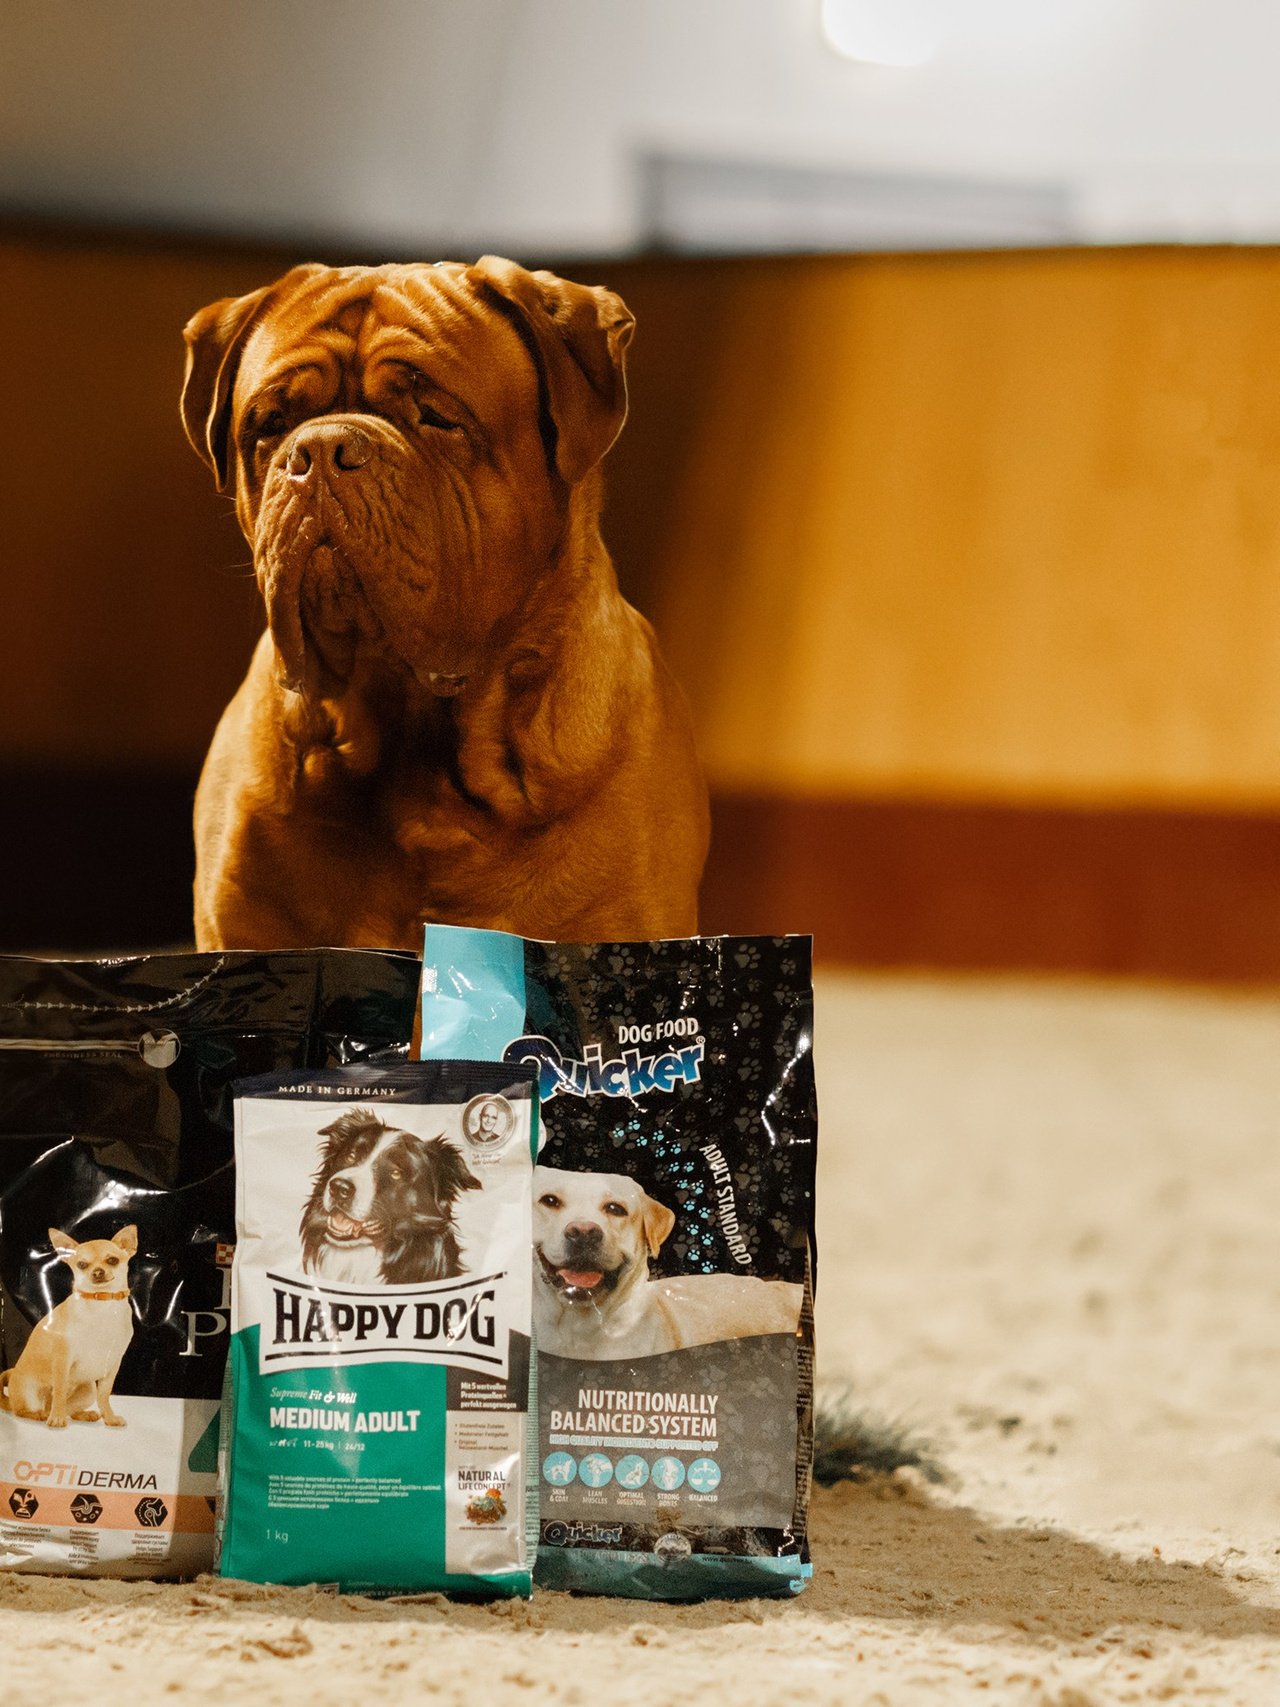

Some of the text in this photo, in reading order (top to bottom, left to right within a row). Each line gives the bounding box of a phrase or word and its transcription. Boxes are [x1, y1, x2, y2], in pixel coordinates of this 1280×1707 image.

[619, 1016, 700, 1045] DOG FOOD
[278, 1085, 396, 1096] MADE IN GERMANY
[698, 1143, 753, 1265] ADULT STANDARD
[272, 1287, 408, 1345] HAPPY
[413, 1289, 496, 1348] DOG
[270, 1387, 357, 1404] Supreme Fit & Well
[578, 1388, 719, 1415] NUTRITIONALLY
[270, 1407, 421, 1433] MEDIUM ADULT
[550, 1410, 717, 1437] BALANCED SYSTEM
[549, 1433, 570, 1445] HIGH
[570, 1434, 604, 1447] QUALITY
[603, 1436, 656, 1449] INGREDIENTS
[656, 1438, 702, 1450] SUPPORTED
[458, 1470, 506, 1481] NATURAL
[551, 1488, 566, 1496] SKIN
[582, 1496, 608, 1505] MUSCLES
[657, 1492, 680, 1501] STRONG
[688, 1494, 718, 1503] BALANCED
[274, 1529, 289, 1544] kg
[543, 1519, 623, 1546] Quicker
